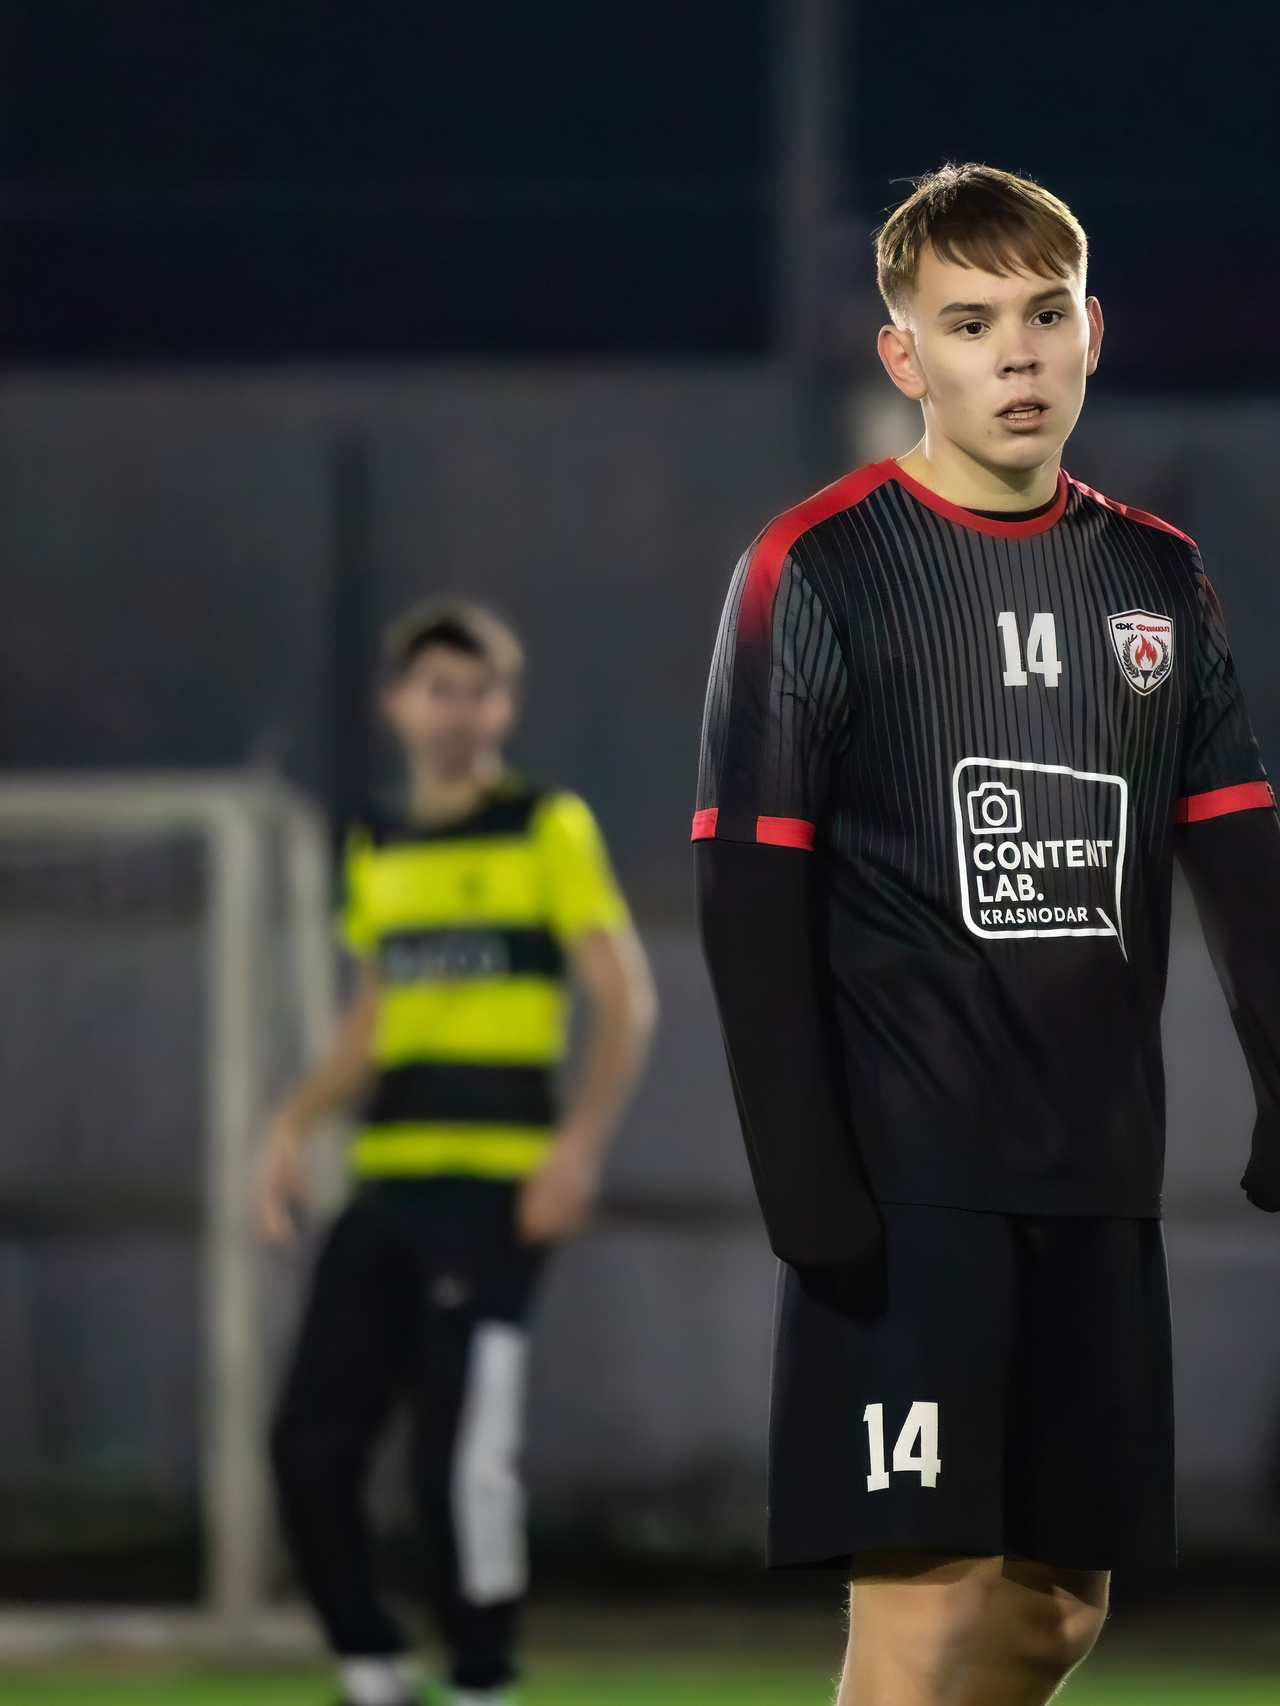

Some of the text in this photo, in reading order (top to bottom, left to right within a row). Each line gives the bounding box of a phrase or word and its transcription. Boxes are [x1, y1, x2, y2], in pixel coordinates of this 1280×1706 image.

[1115, 623, 1134, 631] ФК
[997, 612, 1062, 687] 14
[973, 840, 1112, 871] CONTENT
[977, 874, 1044, 902] LAB.
[980, 907, 1089, 925] KRASNODAR
[863, 1402, 941, 1492] 14
